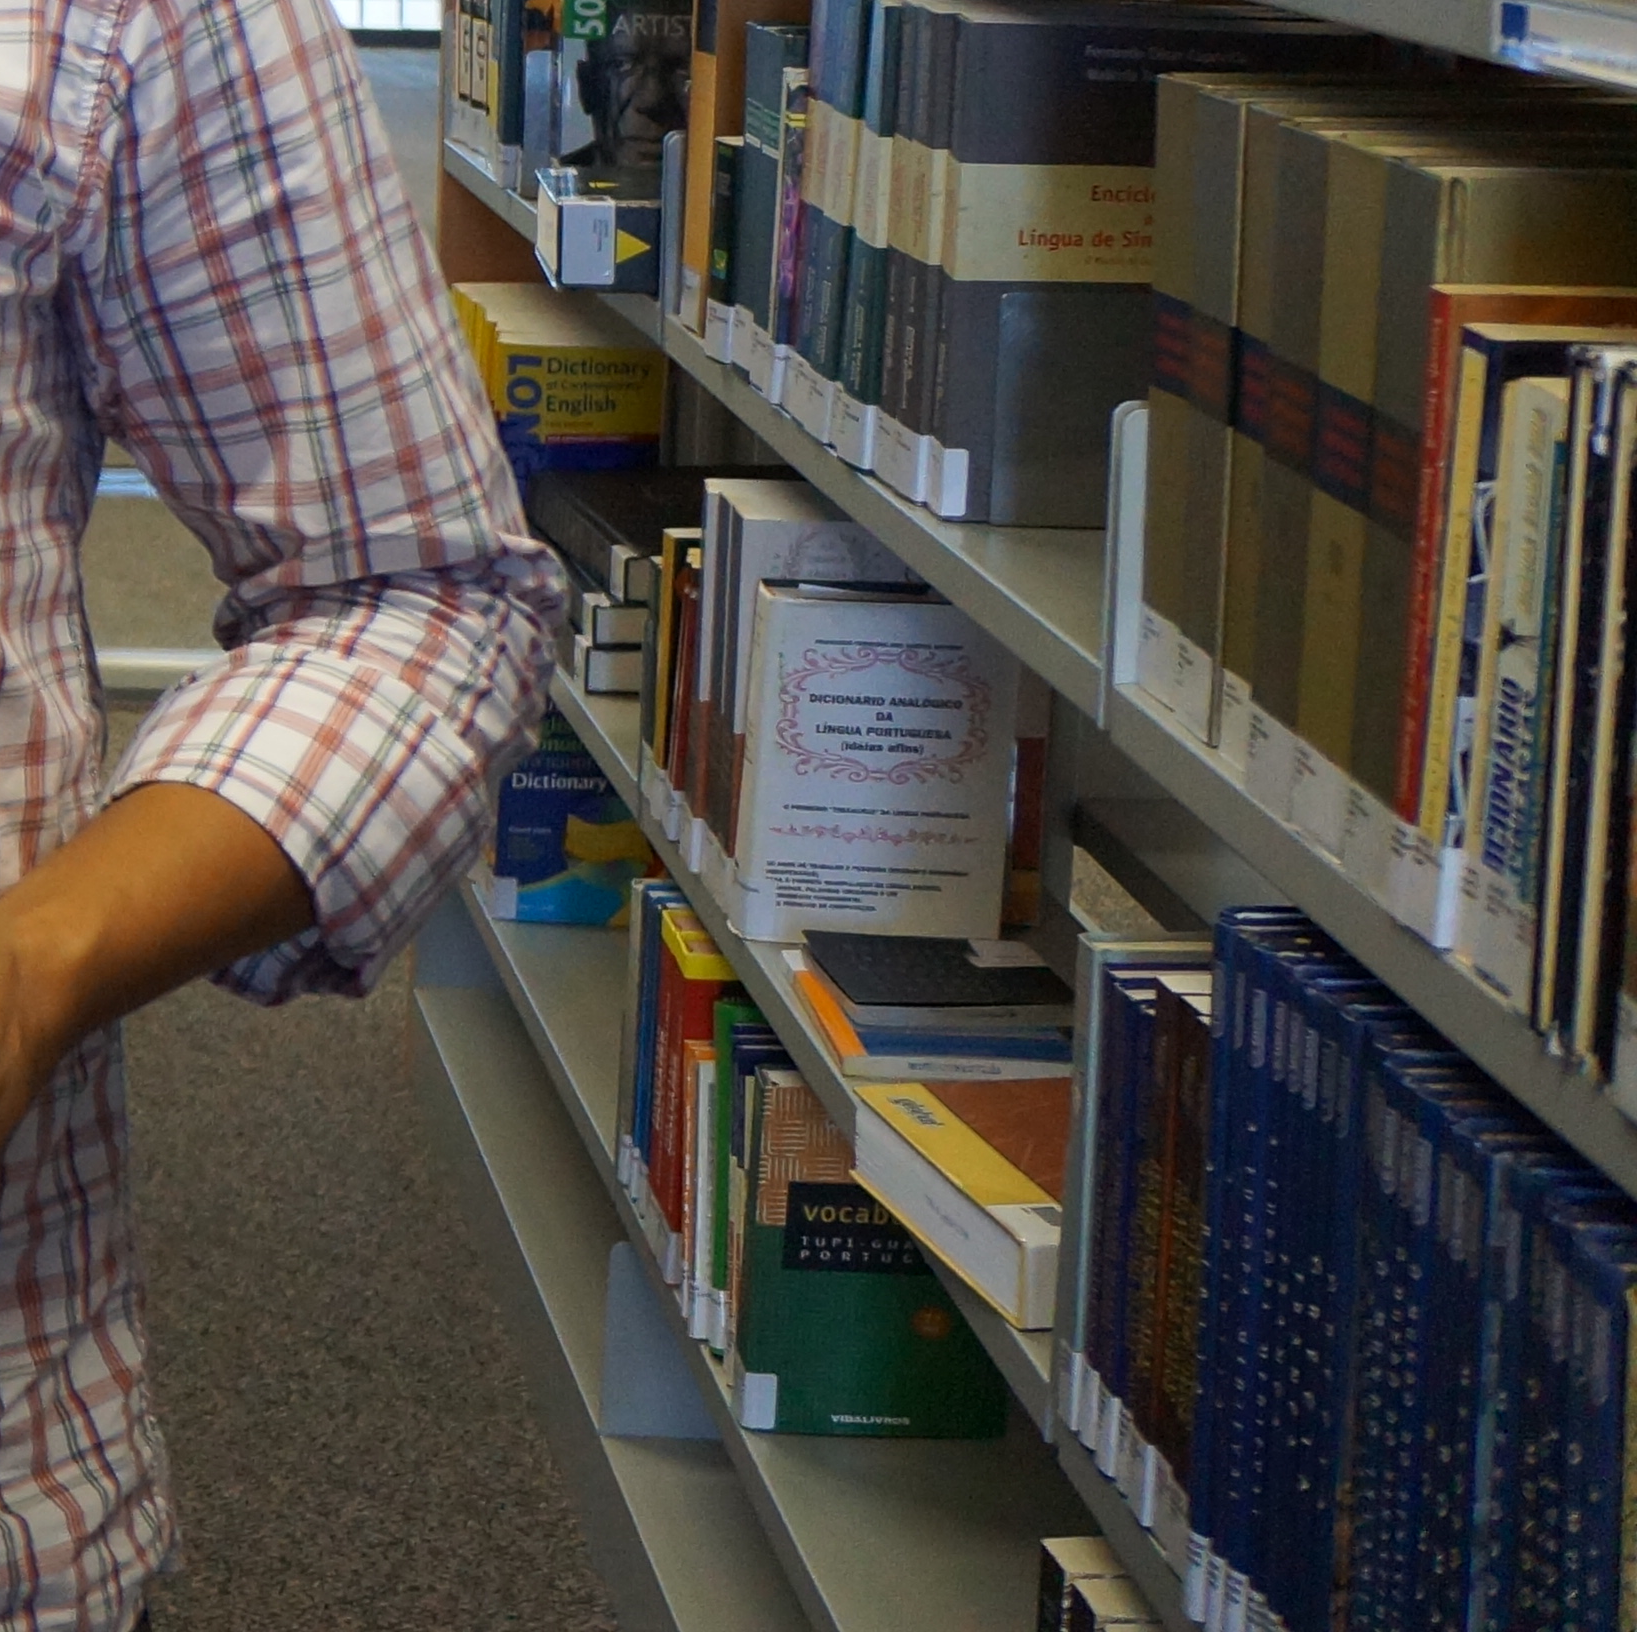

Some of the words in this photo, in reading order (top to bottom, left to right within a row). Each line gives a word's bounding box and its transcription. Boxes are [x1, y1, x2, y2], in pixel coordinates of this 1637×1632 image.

[1091, 229, 1113, 250] de
[545, 356, 650, 380] Dictionary
[546, 394, 618, 415] English
[875, 711, 894, 723] DA
[511, 771, 609, 793] Dictionary
